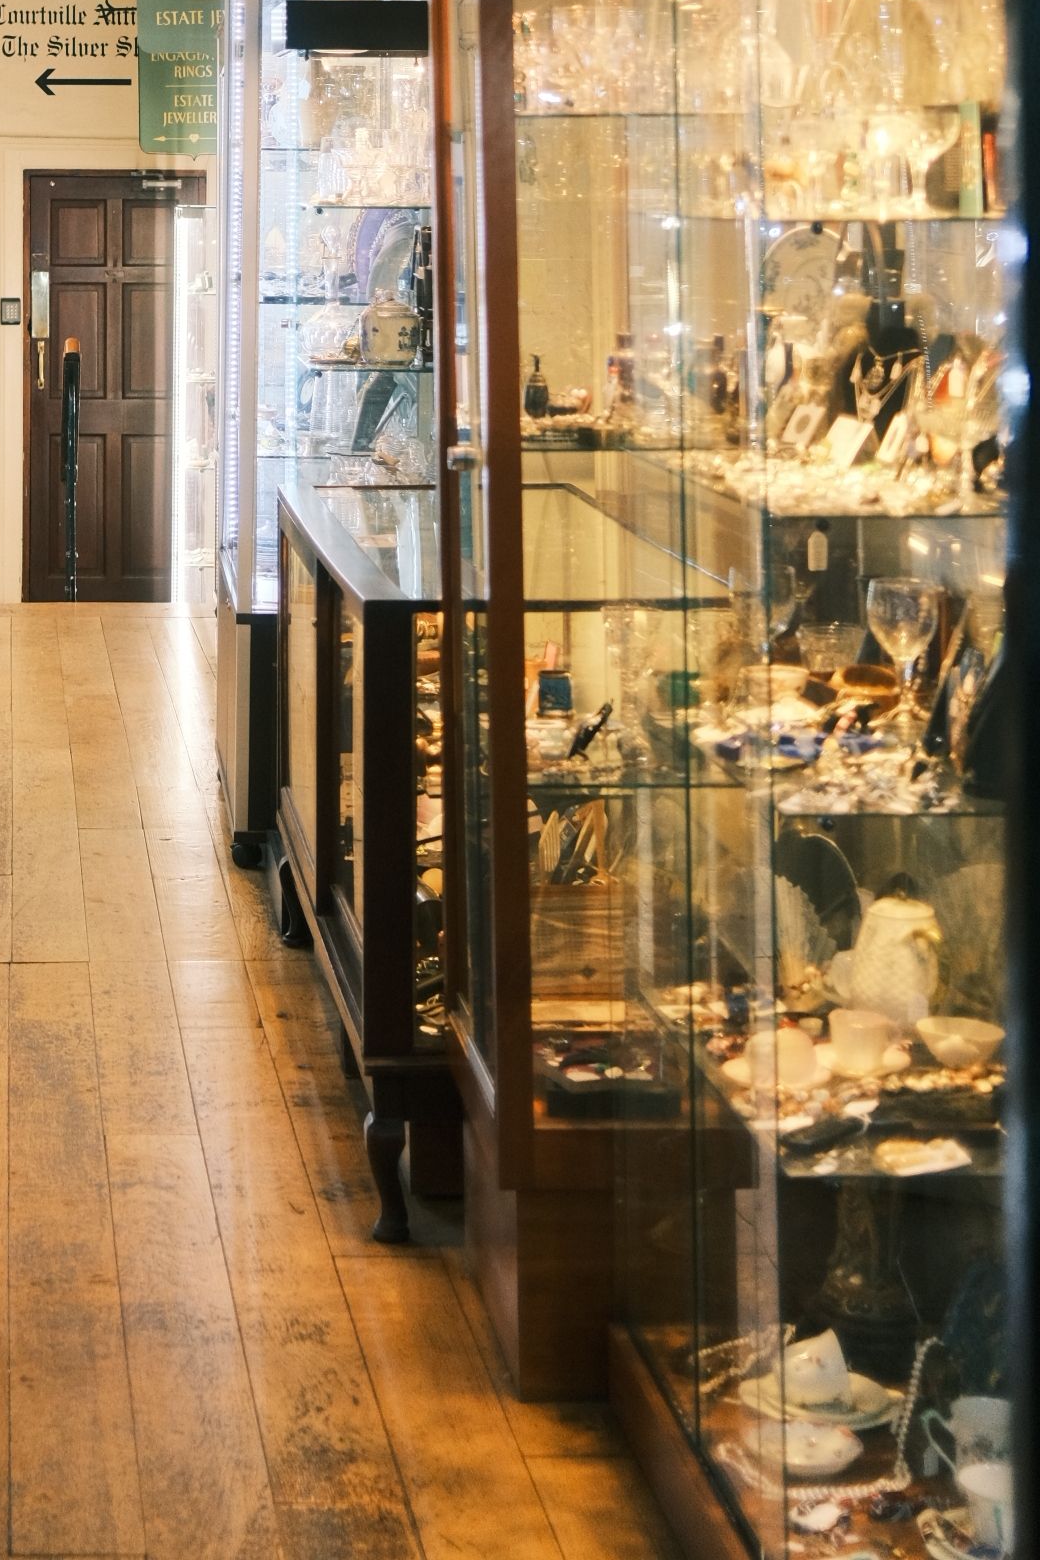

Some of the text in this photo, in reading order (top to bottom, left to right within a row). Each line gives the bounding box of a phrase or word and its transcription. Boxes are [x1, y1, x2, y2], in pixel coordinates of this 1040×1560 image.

[156, 10, 205, 26] ESTATE
[2, 35, 40, 62] The
[47, 35, 109, 58] Silver
[174, 64, 213, 79] RINGS
[174, 94, 215, 108] ESTATE
[163, 111, 217, 127] JEWELLER
